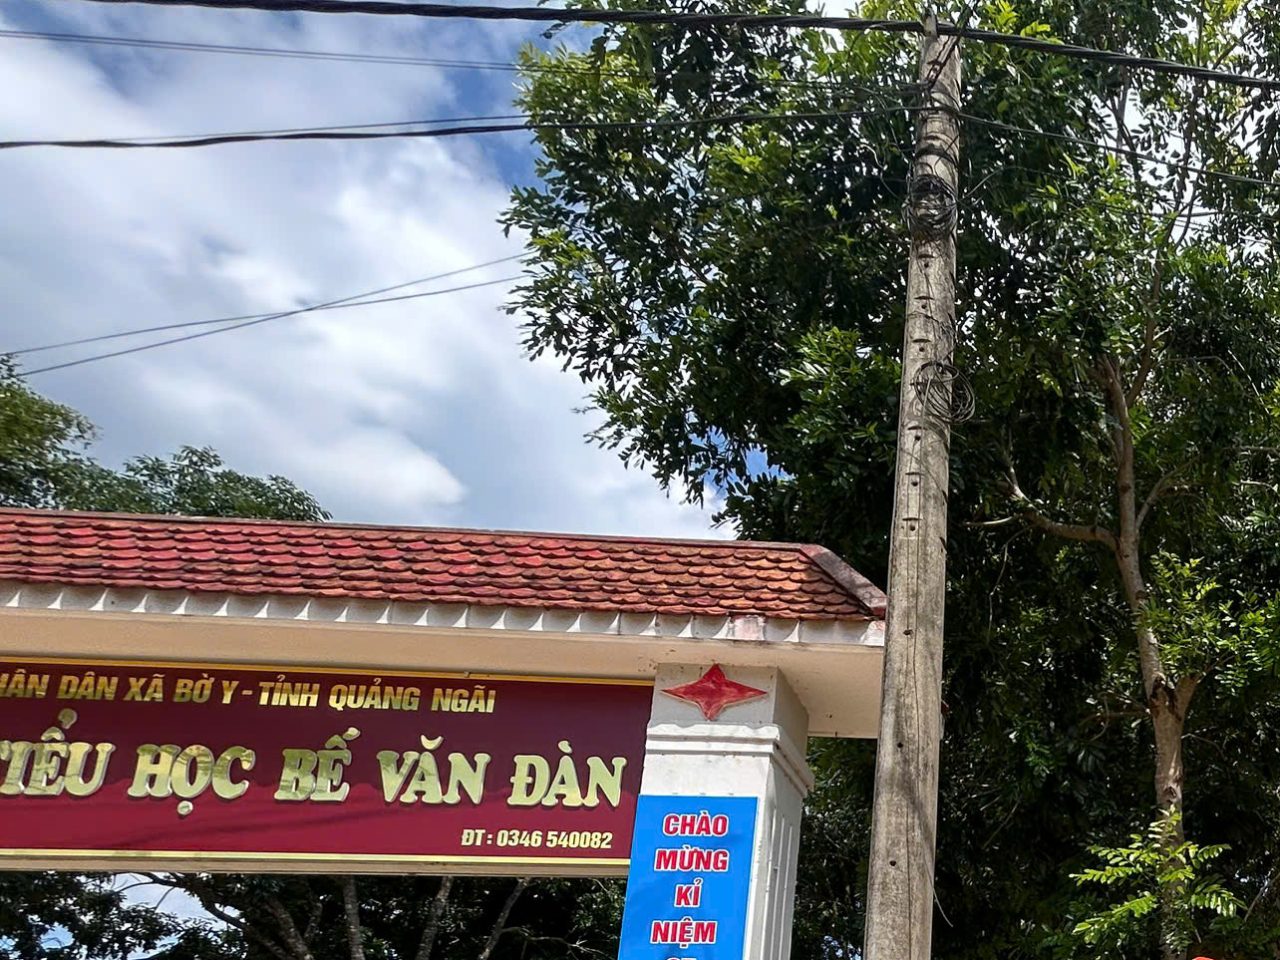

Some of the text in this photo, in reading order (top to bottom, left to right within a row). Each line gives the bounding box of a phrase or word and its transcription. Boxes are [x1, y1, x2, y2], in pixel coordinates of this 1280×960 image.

[56, 671, 118, 700] DÂN
[123, 673, 165, 702] XÃ
[172, 673, 215, 703] BỜ
[221, 680, 240, 704] Y
[258, 675, 320, 707] TỈNH
[328, 678, 420, 711] QUẢNG
[431, 685, 497, 713] NGÃI
[127, 743, 256, 816] HỌC
[274, 726, 361, 802] BẾ
[376, 734, 491, 805] VĂN
[506, 739, 627, 808] ĐÀN
[663, 811, 729, 836] CHÀO
[496, 830, 548, 847] 0346
[546, 832, 612, 849] 540082
[654, 846, 729, 871] MỪNG
[674, 878, 703, 907] KỈ
[651, 917, 717, 948] NIỆM
